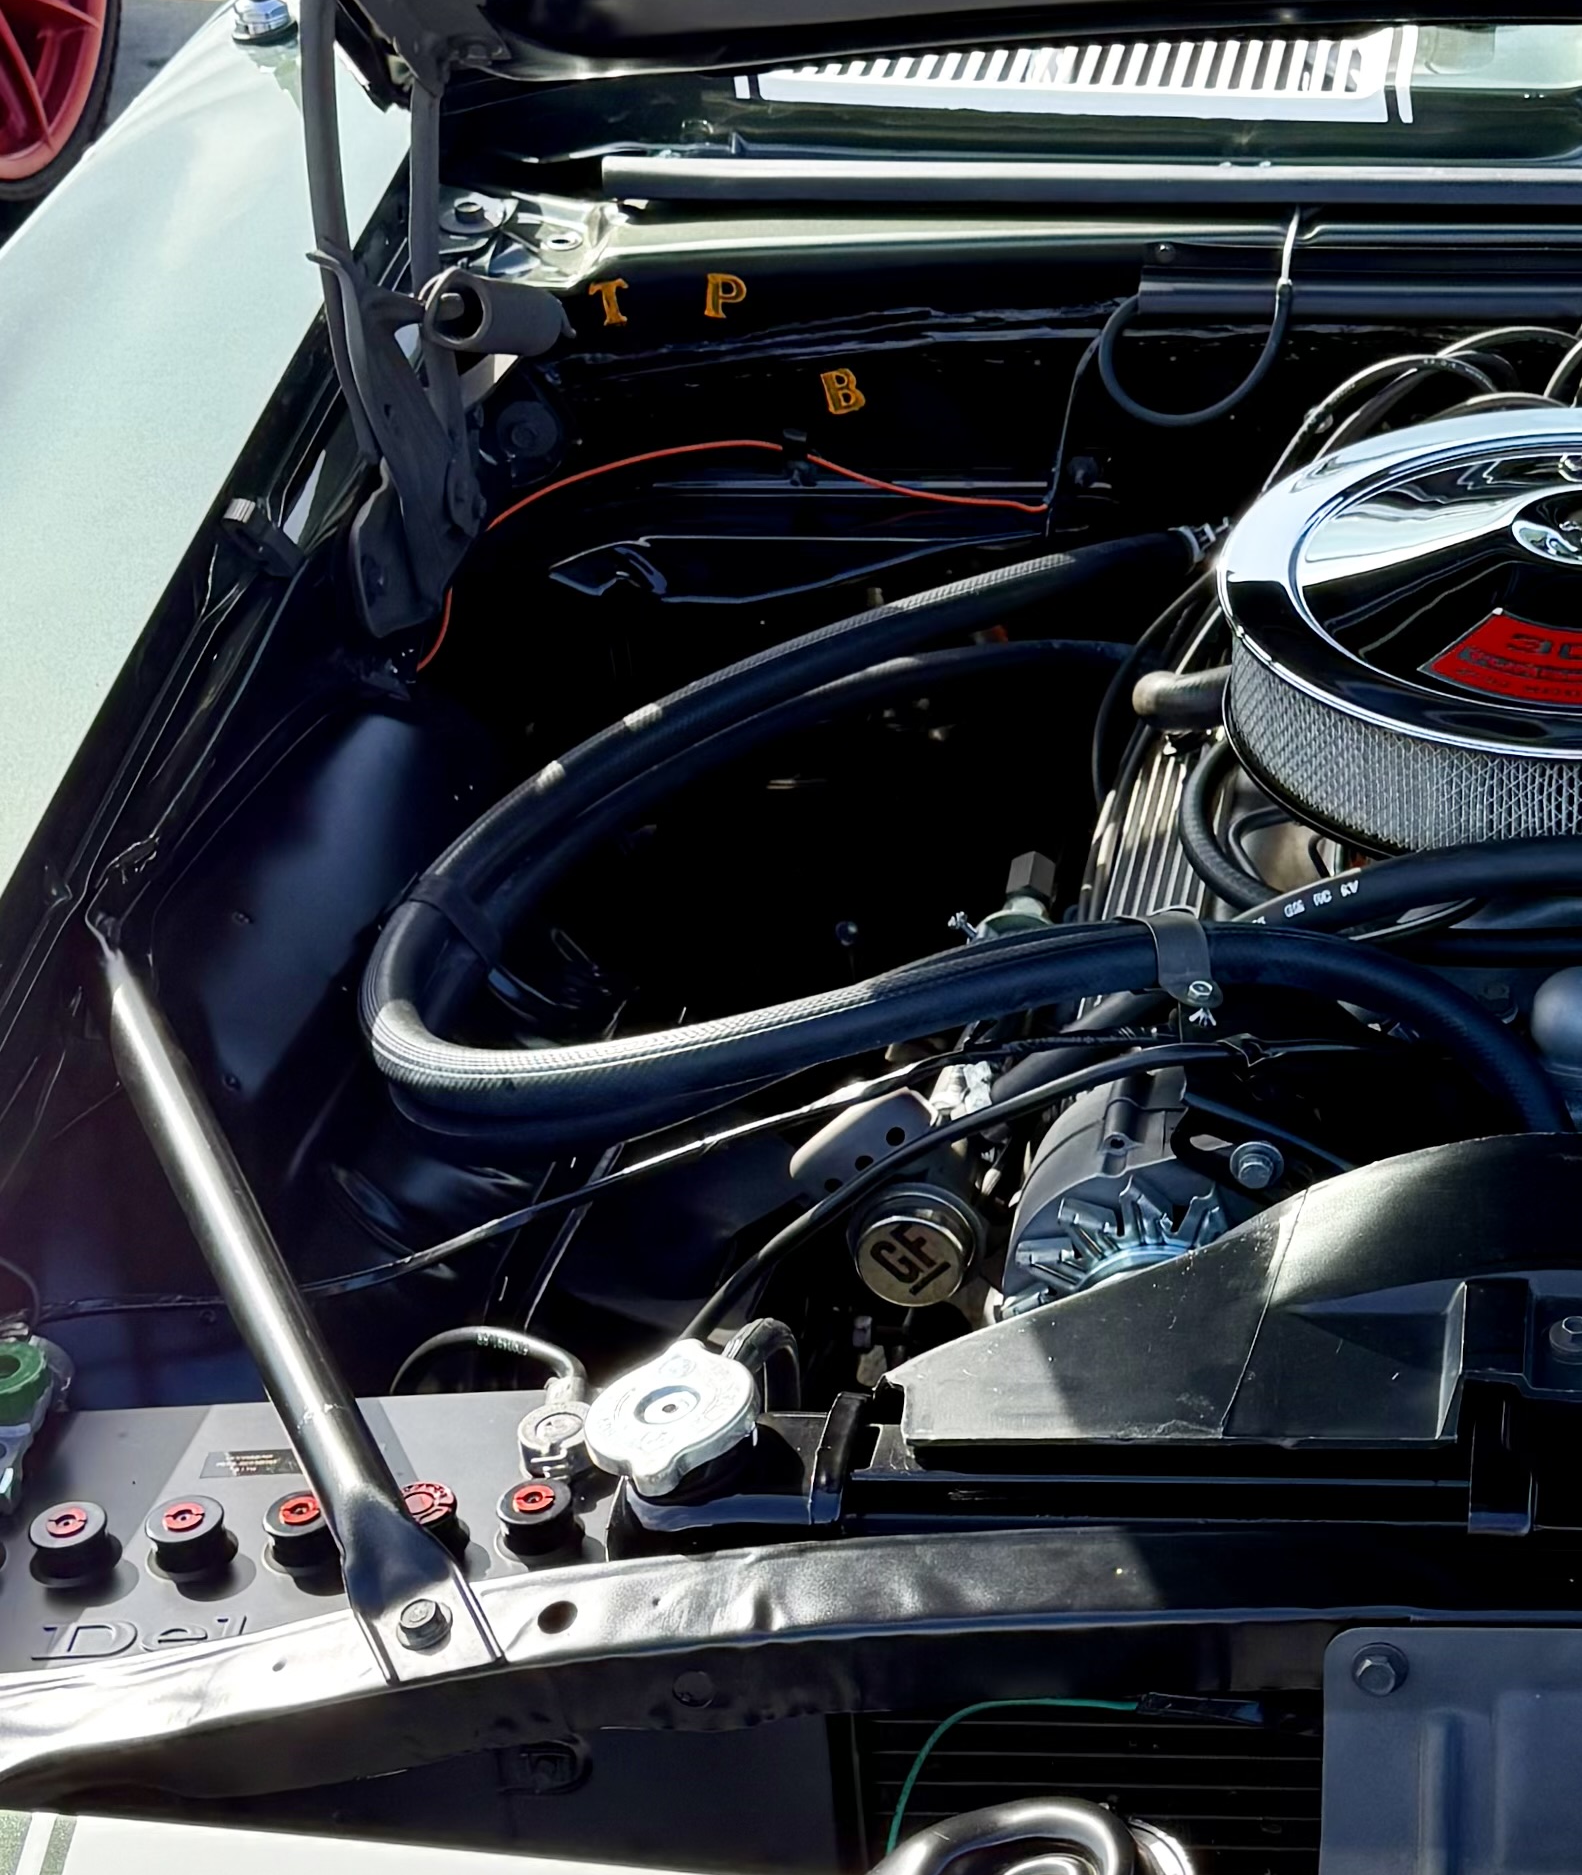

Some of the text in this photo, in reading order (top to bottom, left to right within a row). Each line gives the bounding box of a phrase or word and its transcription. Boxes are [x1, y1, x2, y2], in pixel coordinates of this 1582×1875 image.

[588, 272, 748, 326] T P
[819, 367, 867, 415] B
